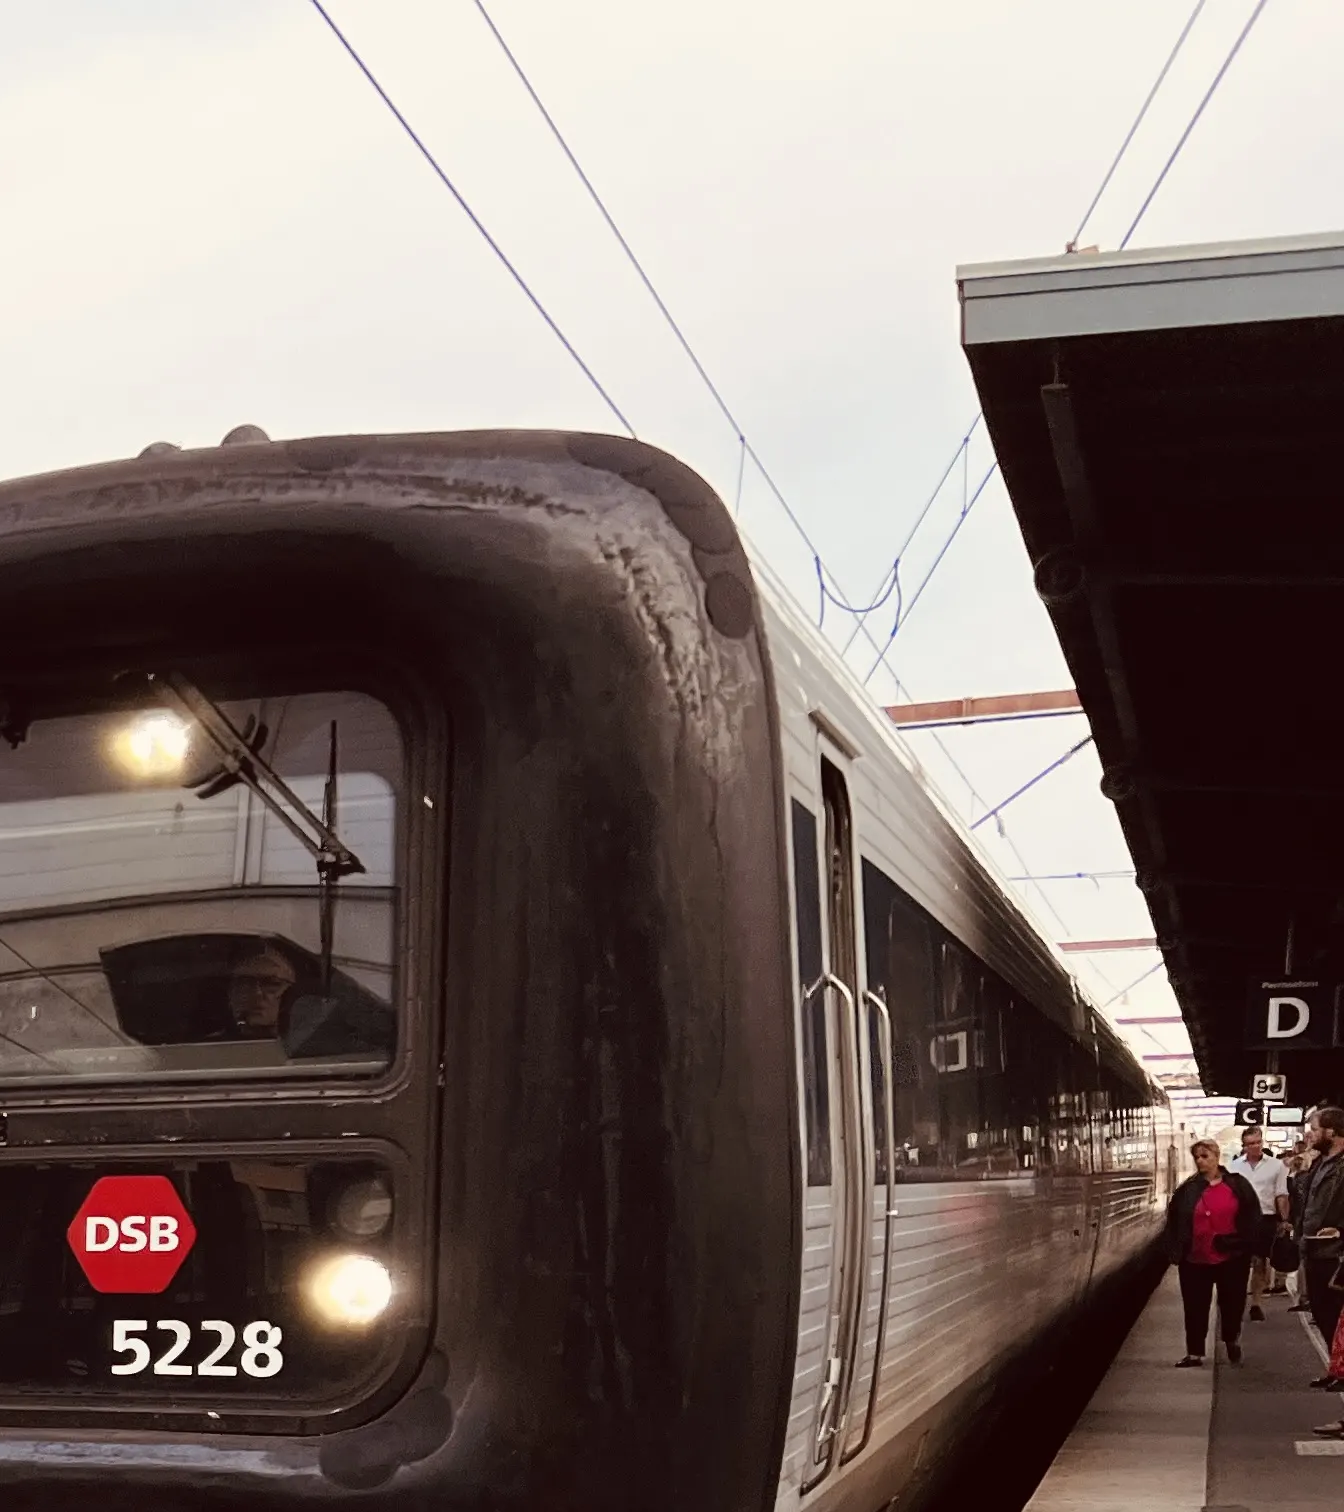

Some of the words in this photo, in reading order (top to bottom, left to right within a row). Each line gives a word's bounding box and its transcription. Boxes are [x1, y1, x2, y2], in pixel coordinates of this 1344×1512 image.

[1267, 997, 1310, 1039] D
[1242, 1107, 1257, 1124] C
[85, 1216, 179, 1252] DSB
[111, 1319, 284, 1378] 5228
